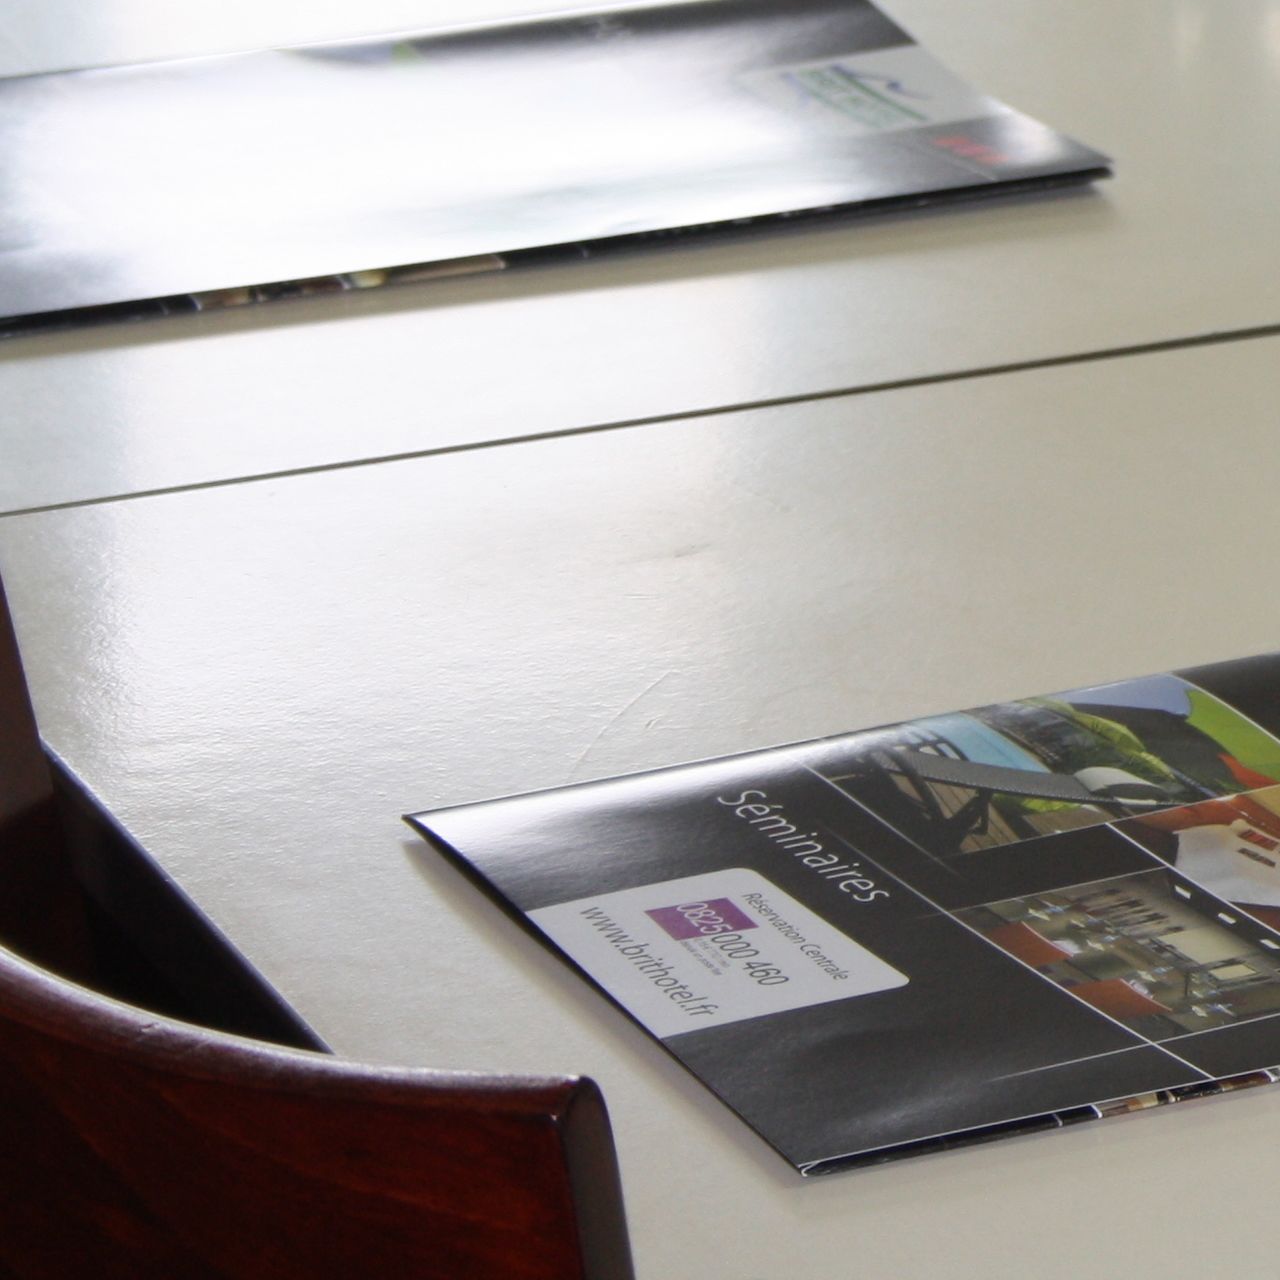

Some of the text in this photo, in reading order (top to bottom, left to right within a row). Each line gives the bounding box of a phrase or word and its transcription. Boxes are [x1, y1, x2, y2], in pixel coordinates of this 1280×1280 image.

[716, 789, 890, 904] Séminaires
[580, 906, 717, 1019] www.brithotel.fr
[741, 891, 849, 982] Réservation Centrale
[742, 961, 790, 986] 460
